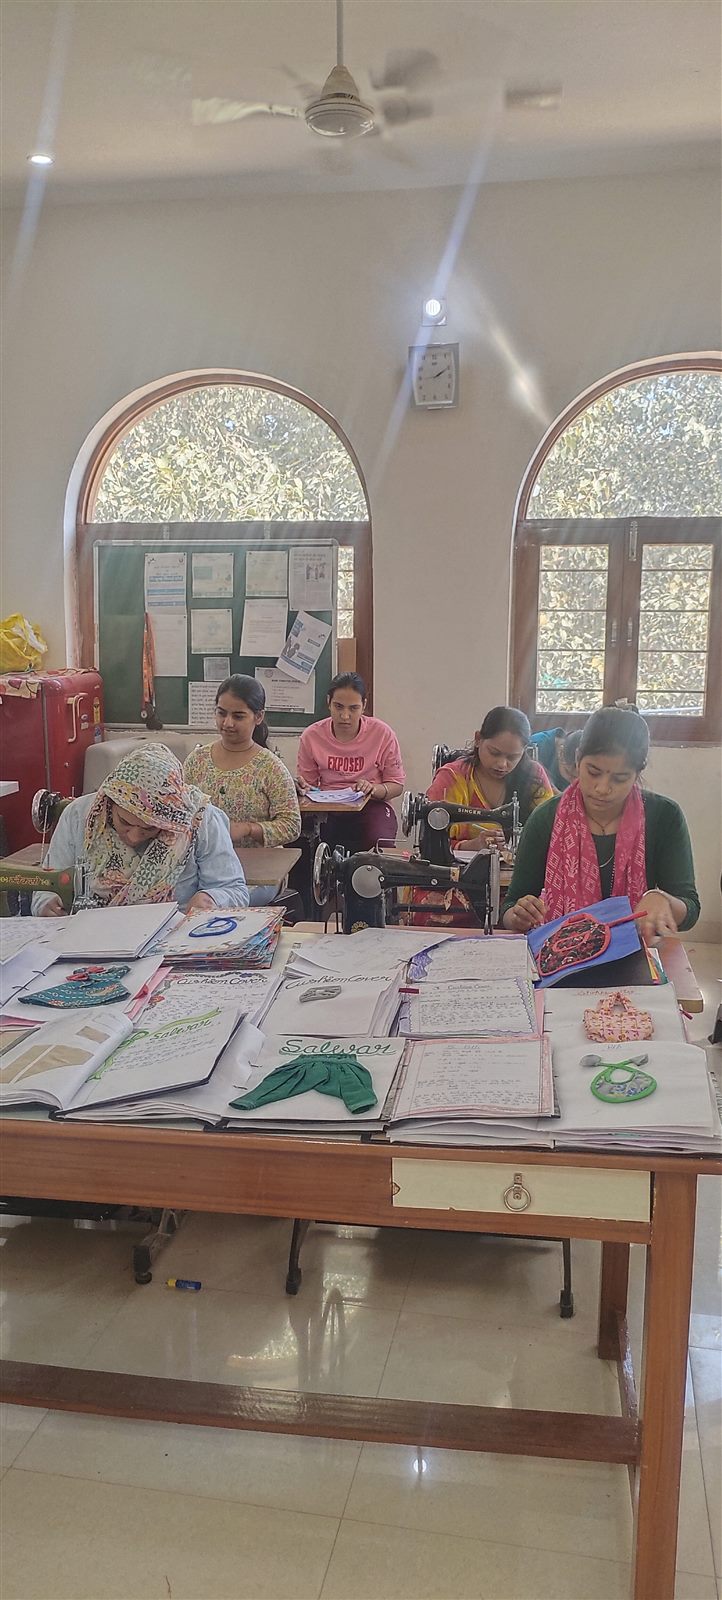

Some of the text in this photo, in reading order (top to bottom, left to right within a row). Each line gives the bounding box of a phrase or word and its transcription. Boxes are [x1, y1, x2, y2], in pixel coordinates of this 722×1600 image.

[328, 756, 364, 772] EXPOSED
[457, 807, 481, 815] SINGER
[279, 1039, 397, 1055] Salwar
